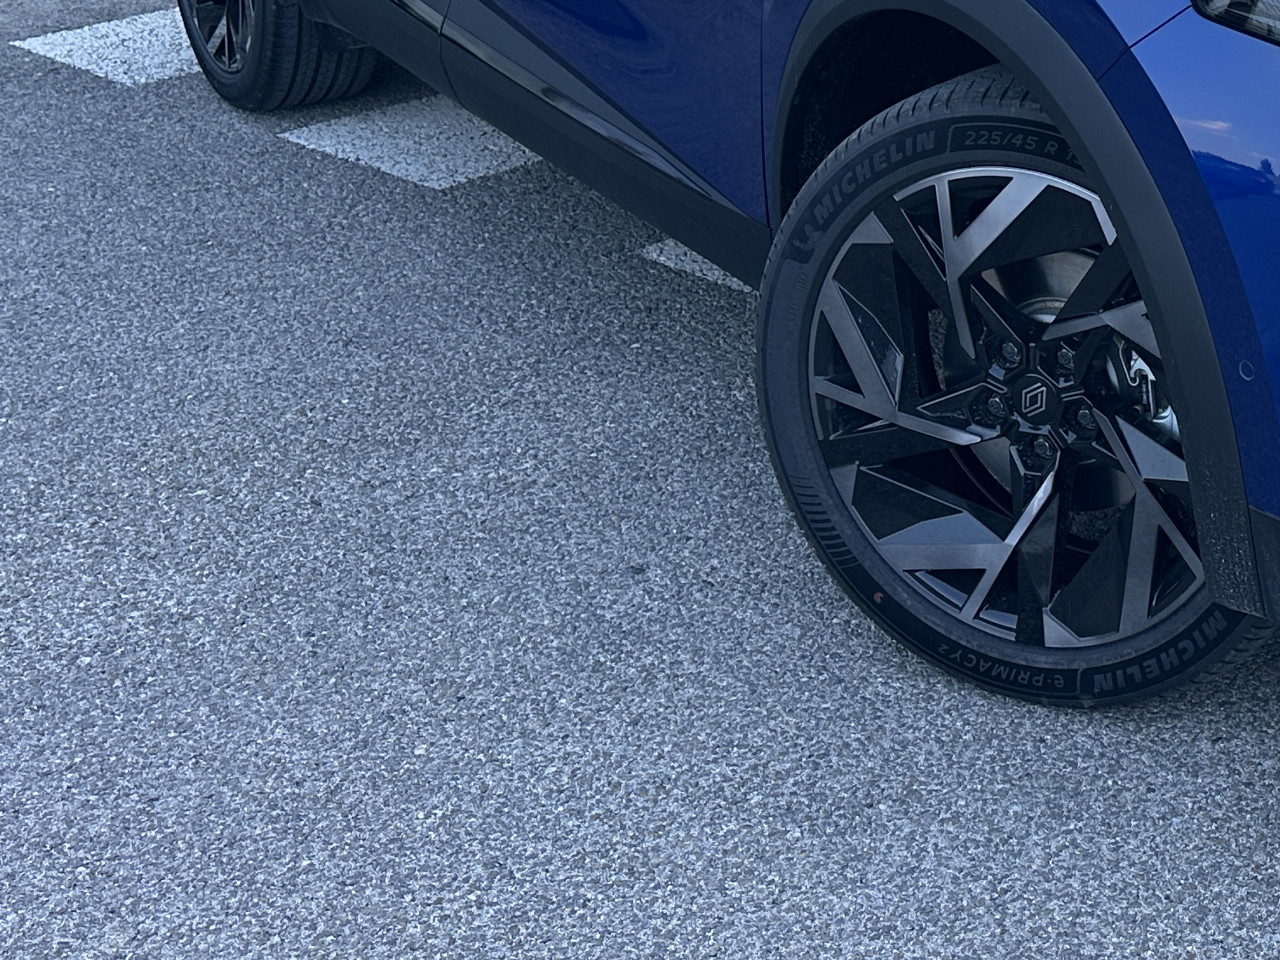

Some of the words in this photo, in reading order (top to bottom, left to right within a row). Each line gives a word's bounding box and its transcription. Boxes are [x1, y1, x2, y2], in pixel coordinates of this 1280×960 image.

[811, 129, 937, 226] MICHELIN
[964, 130, 1040, 154] 225/45
[1044, 141, 1059, 156] R
[1093, 608, 1230, 693] MICHELIN
